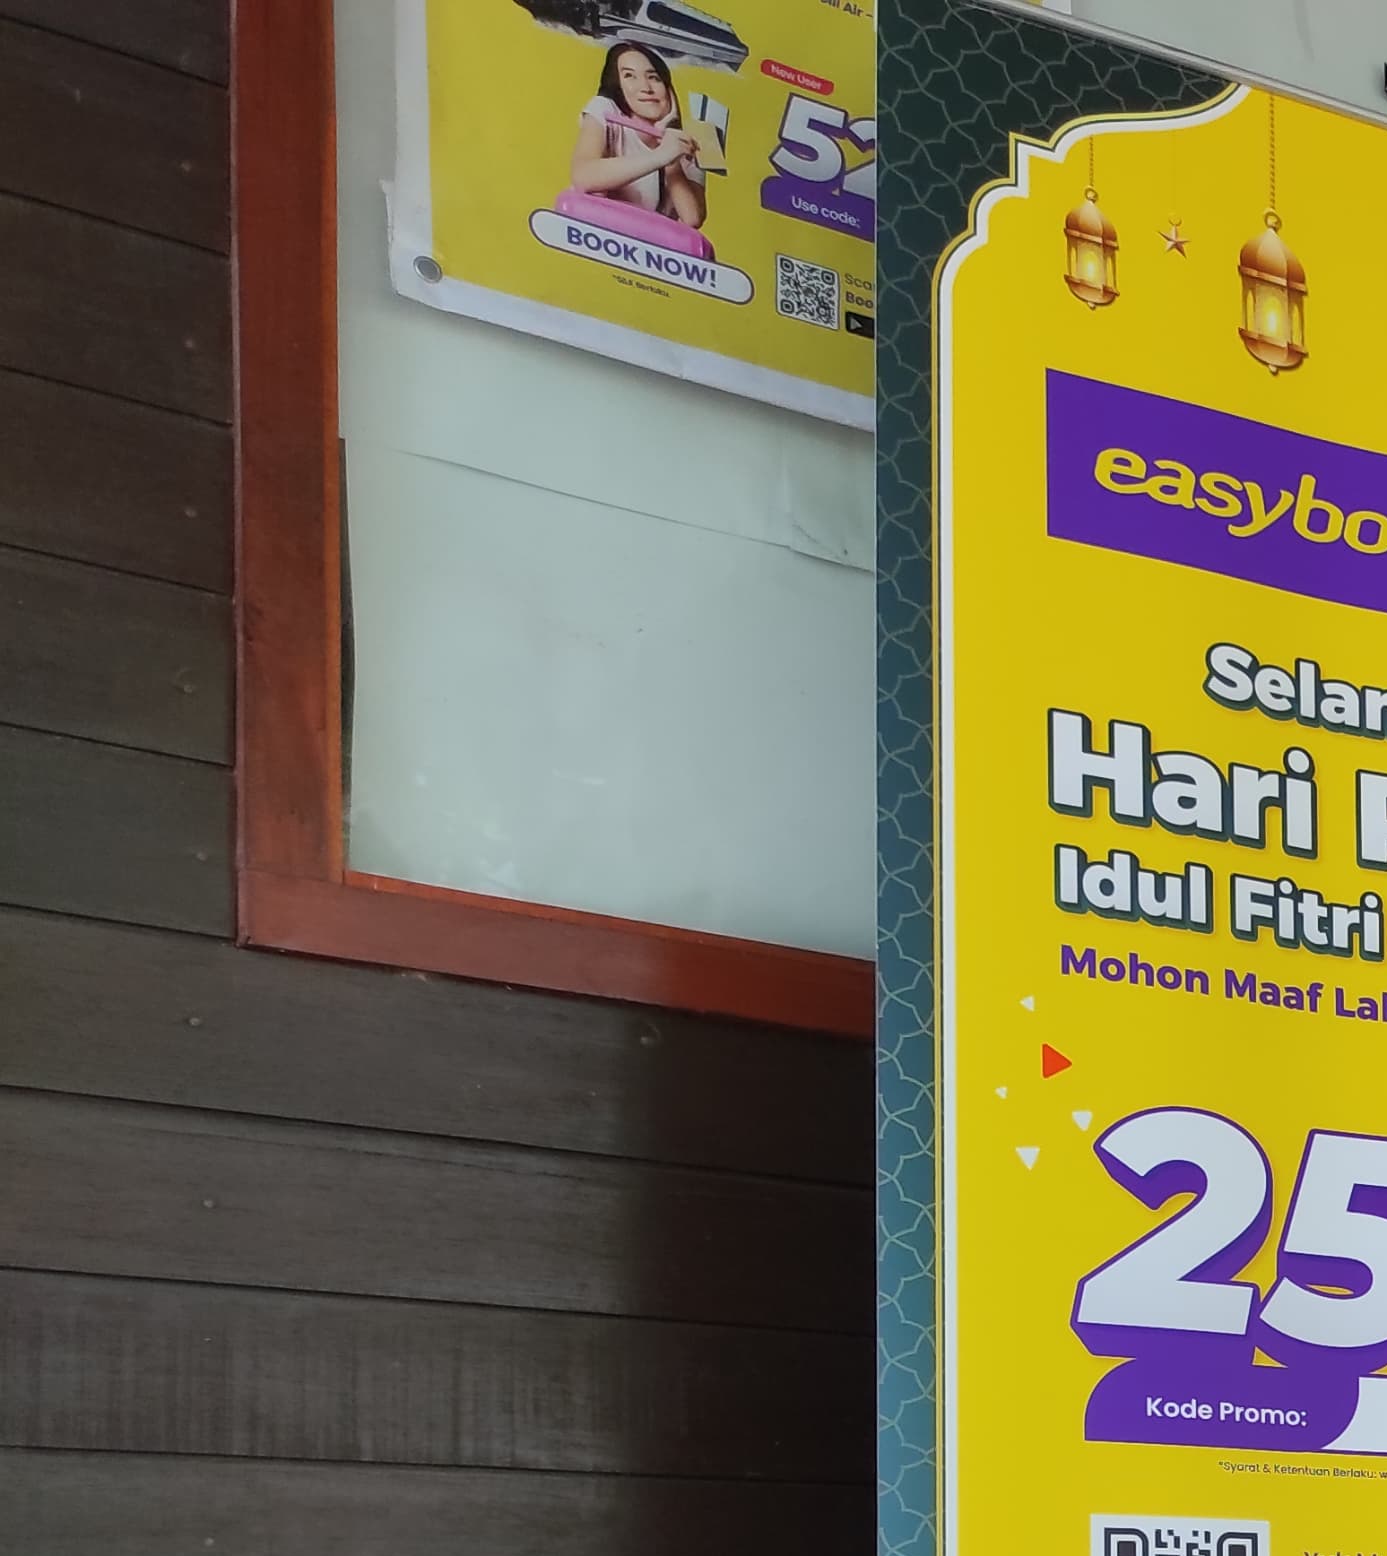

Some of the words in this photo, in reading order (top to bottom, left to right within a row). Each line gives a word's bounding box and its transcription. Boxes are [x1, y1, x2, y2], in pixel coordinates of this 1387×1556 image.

[843, 2, 864, 17] Air
[797, 74, 822, 91] User
[792, 195, 819, 214] Use
[820, 206, 861, 230] code:
[566, 224, 640, 265] BOOK
[644, 252, 718, 289] NOW!
[844, 272, 874, 291] Sca
[845, 290, 875, 309] Boo
[1047, 707, 1318, 860] Hari
[1053, 843, 1214, 934] Idul
[1230, 872, 1385, 961] Fitri
[1060, 945, 1210, 995] Mohon
[1223, 967, 1323, 1014] Maaf
[1145, 1395, 1215, 1421] Kode
[1218, 1400, 1308, 1428] Promo:
[1273, 1463, 1330, 1477] Ketentuan
[1333, 1467, 1377, 1479] Berlaku:
